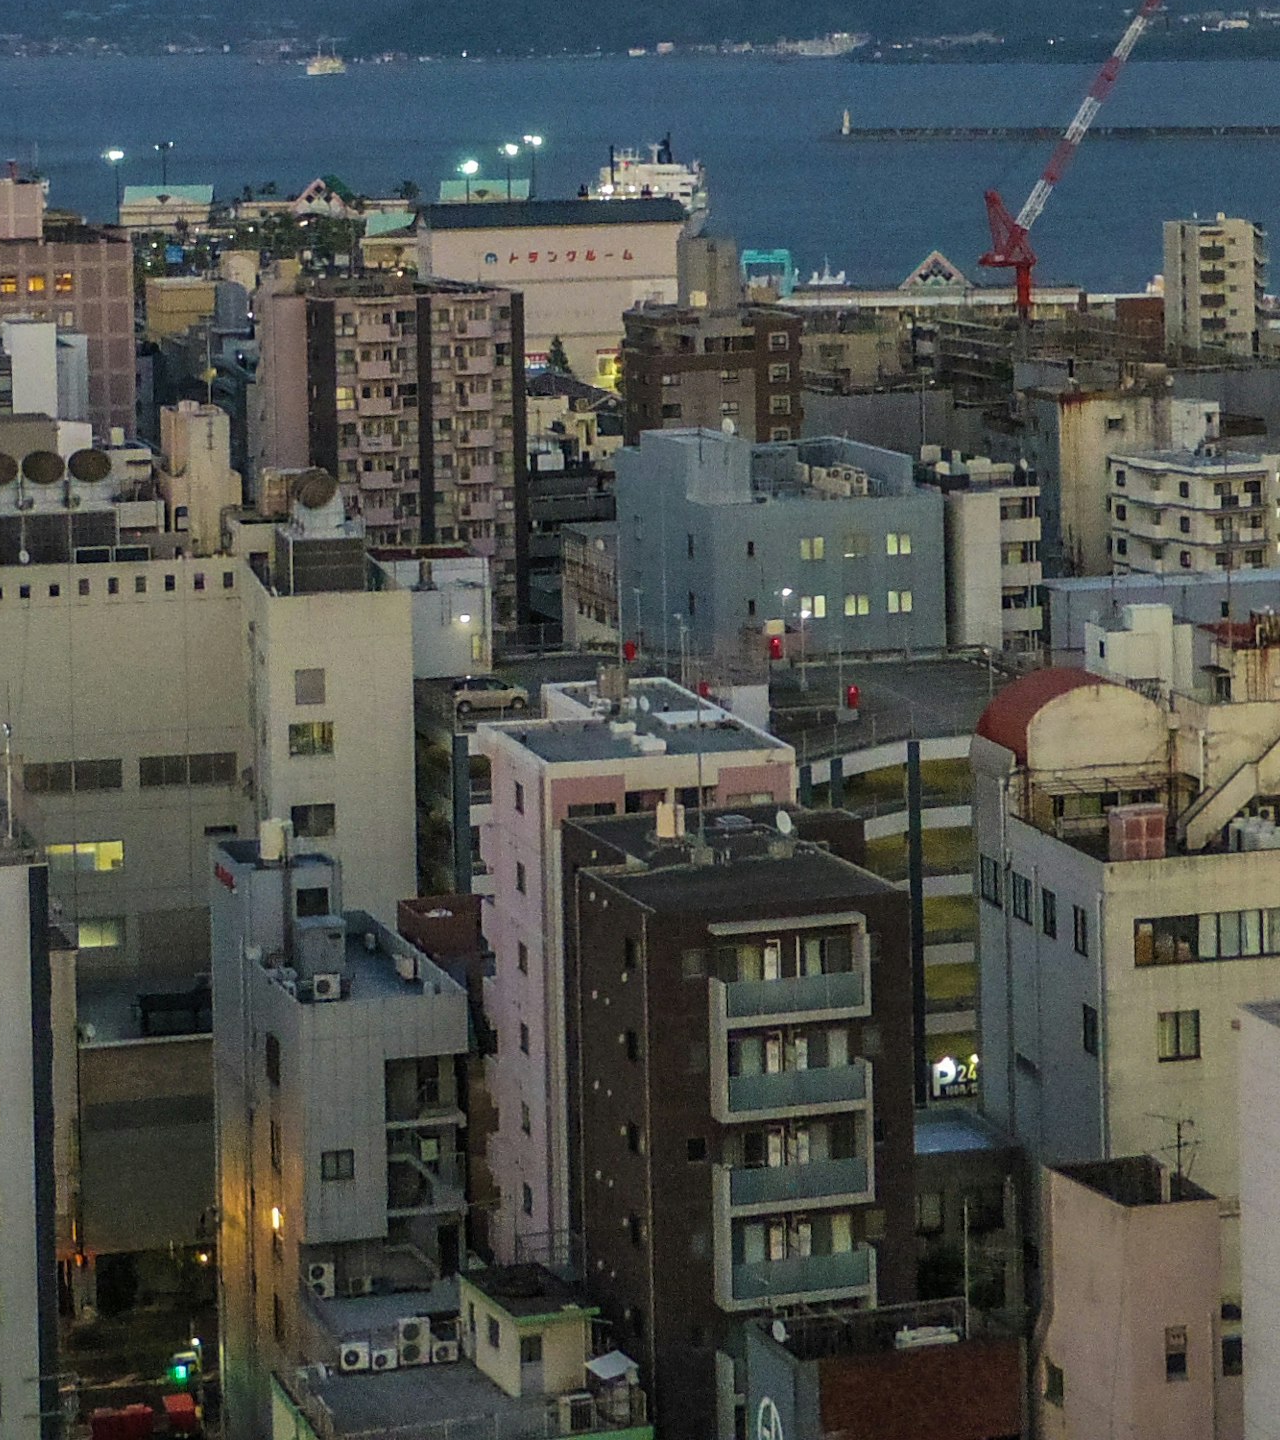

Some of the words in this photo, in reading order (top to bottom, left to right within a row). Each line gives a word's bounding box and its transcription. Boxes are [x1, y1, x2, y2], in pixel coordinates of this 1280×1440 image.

[509, 249, 633, 263] トランクルーム
